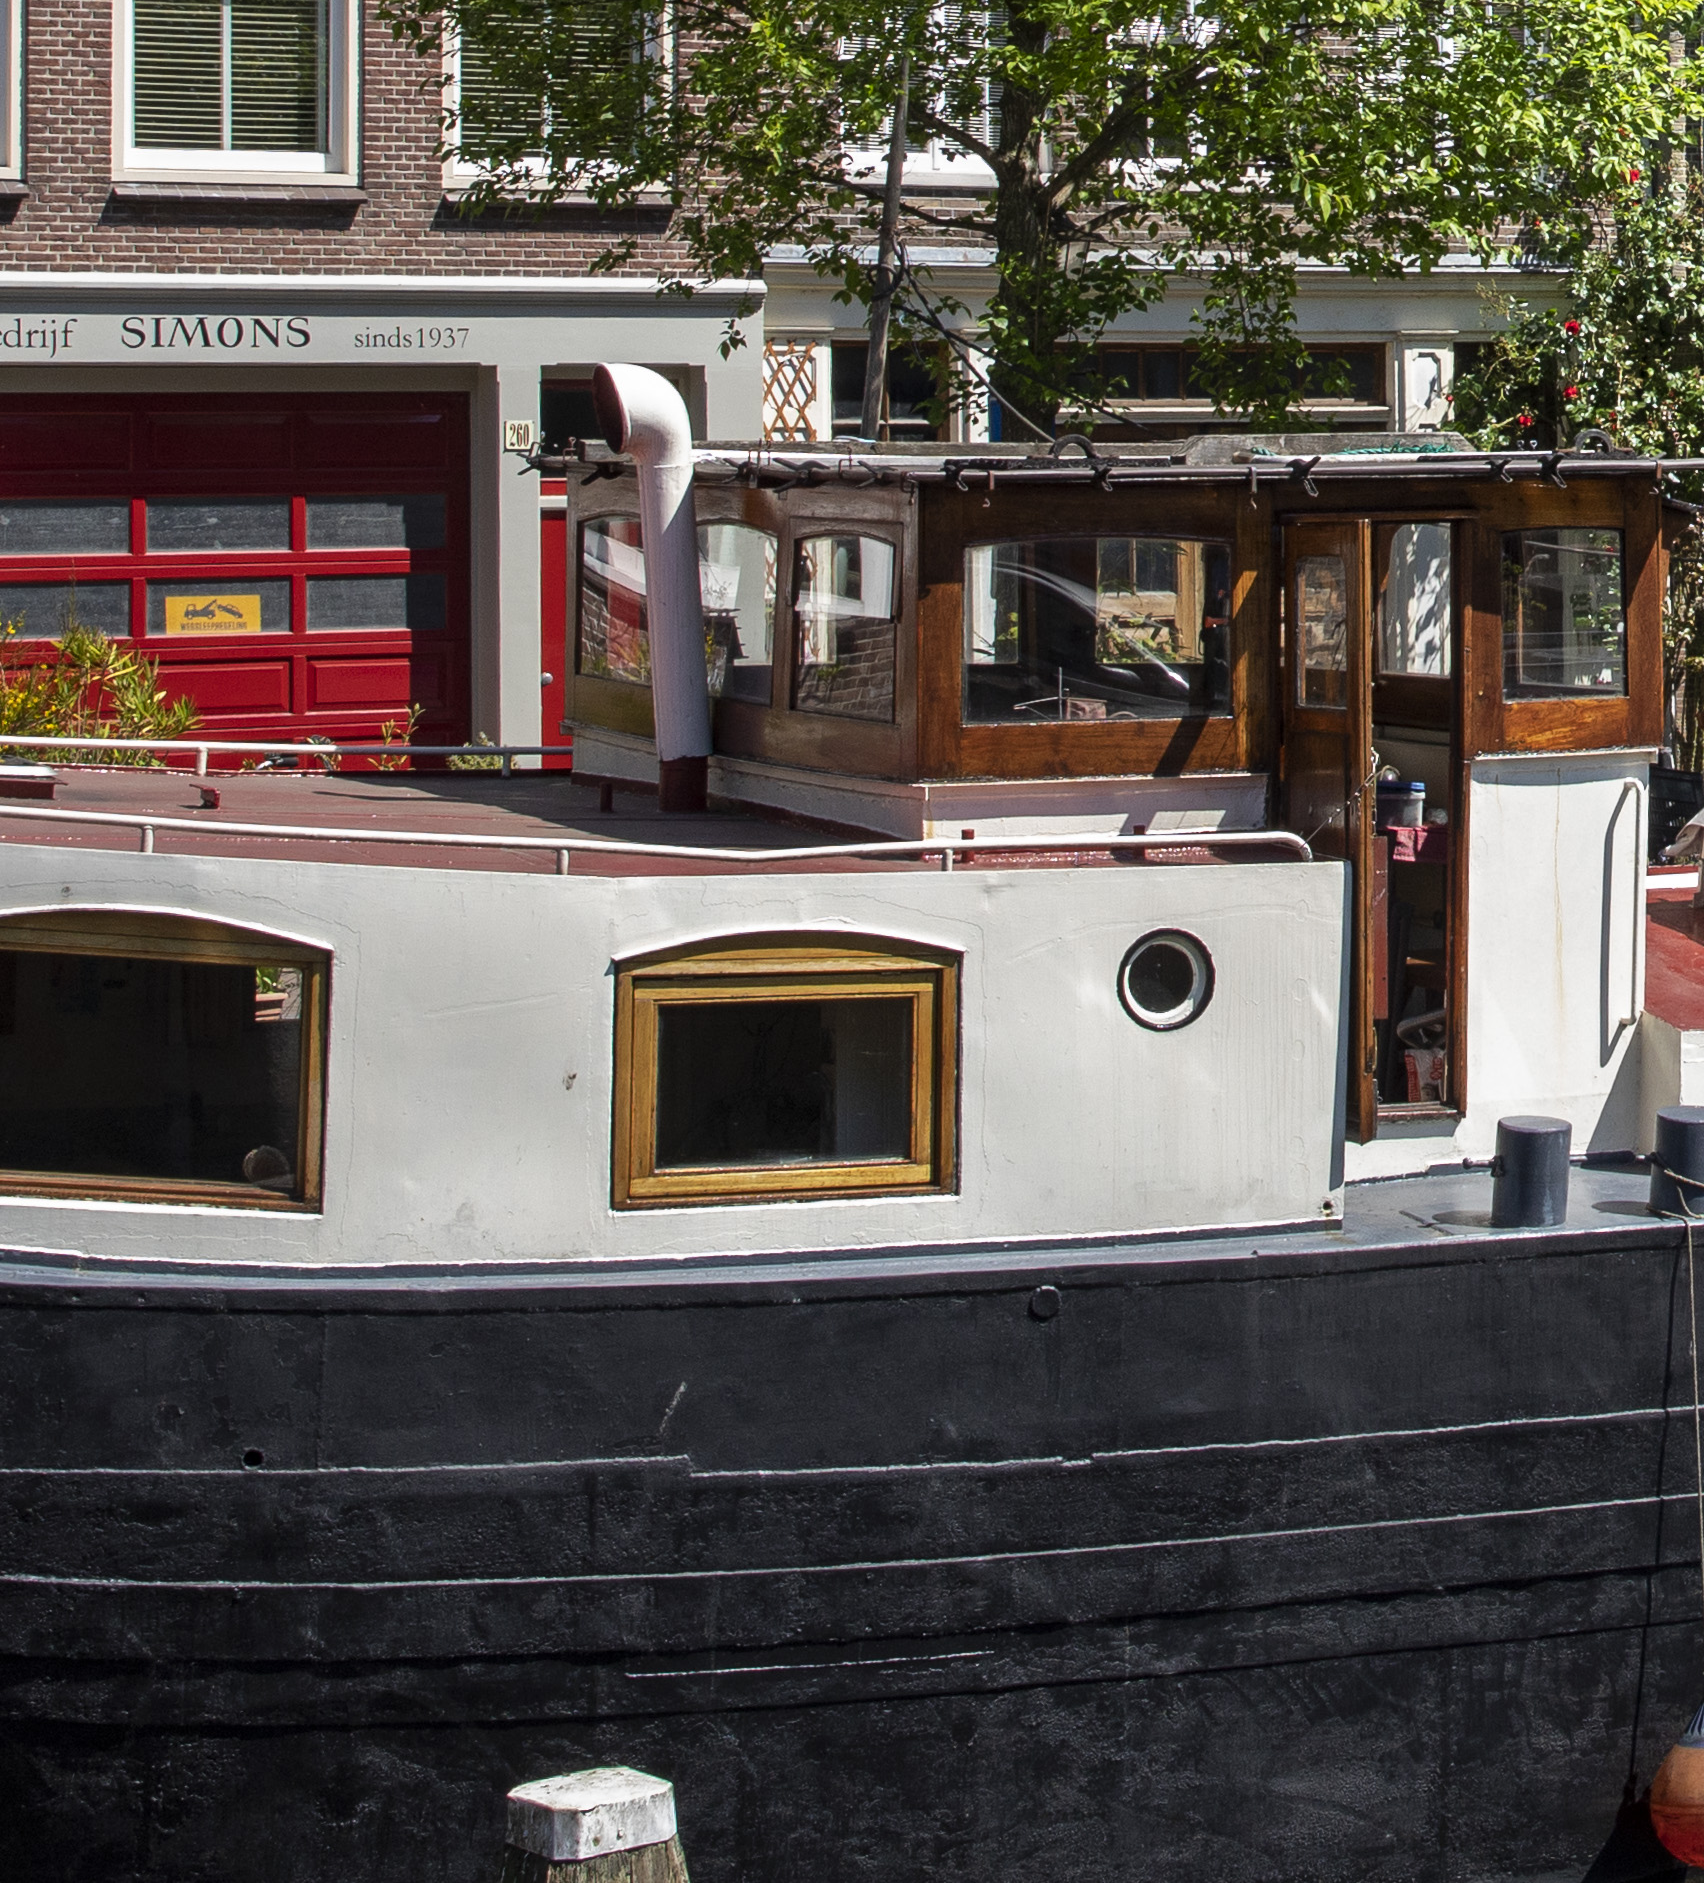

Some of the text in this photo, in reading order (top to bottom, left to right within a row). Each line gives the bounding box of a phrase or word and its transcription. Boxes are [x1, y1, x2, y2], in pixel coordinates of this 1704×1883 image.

[0, 317, 78, 358] drijf
[121, 316, 311, 349] SIMONS
[509, 423, 530, 447] 260
